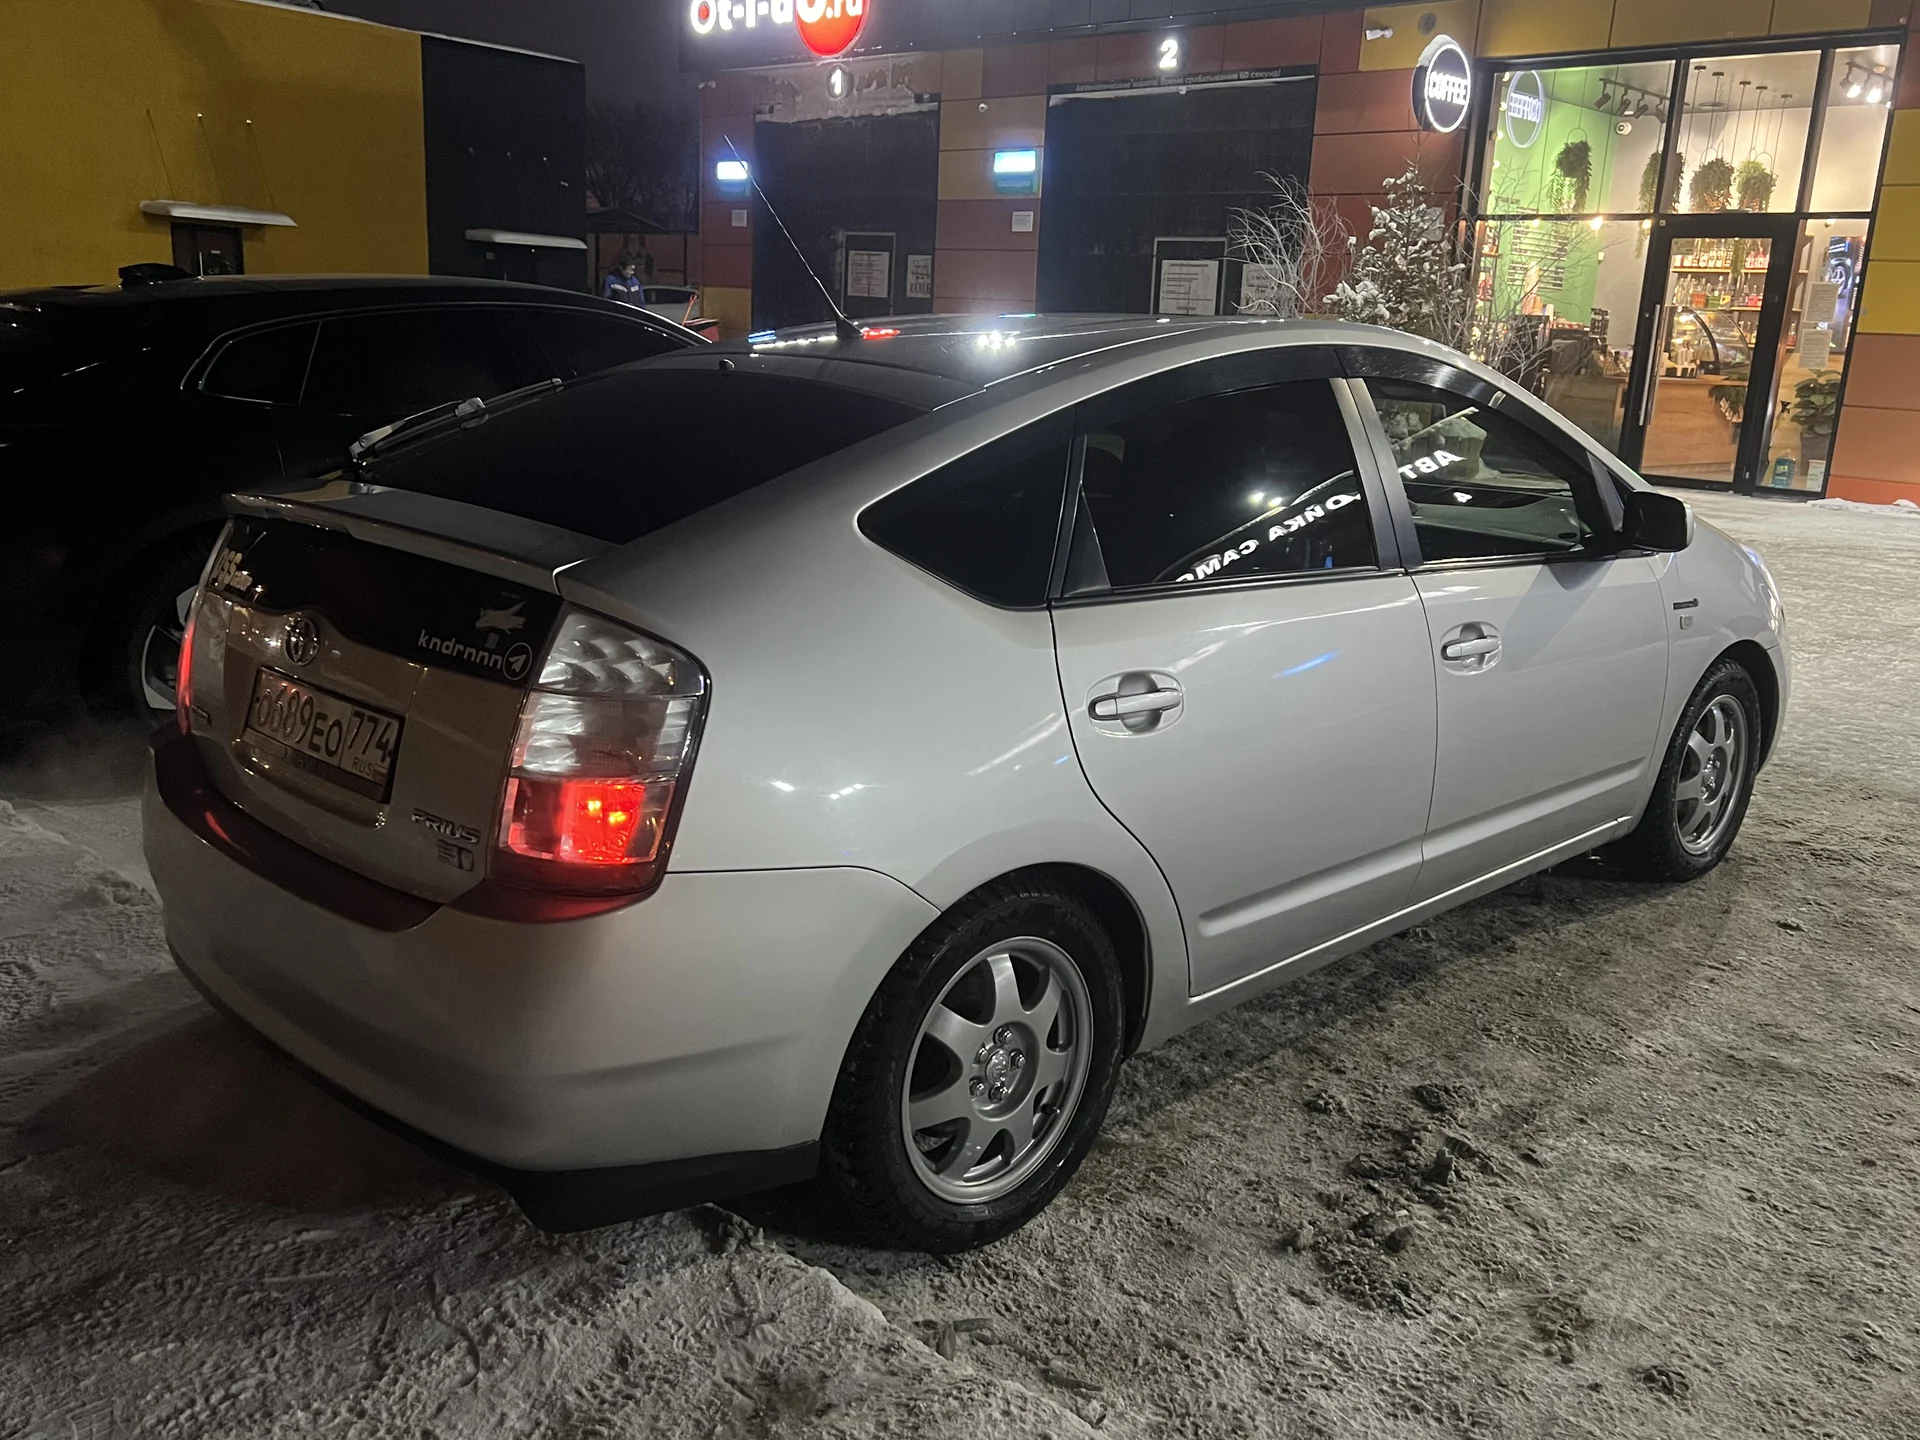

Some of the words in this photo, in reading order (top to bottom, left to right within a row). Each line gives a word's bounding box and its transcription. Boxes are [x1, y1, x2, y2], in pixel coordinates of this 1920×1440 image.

[1159, 38, 1179, 69] 2
[830, 68, 843, 95] 1
[1239, 71, 1249, 79] 60
[1250, 69, 1281, 79] секунд!
[1428, 71, 1468, 105] COFFEE
[418, 629, 503, 669] kndrnnn
[348, 710, 391, 763] 774
[351, 757, 374, 777] RUS
[411, 807, 480, 844] PRIUS
